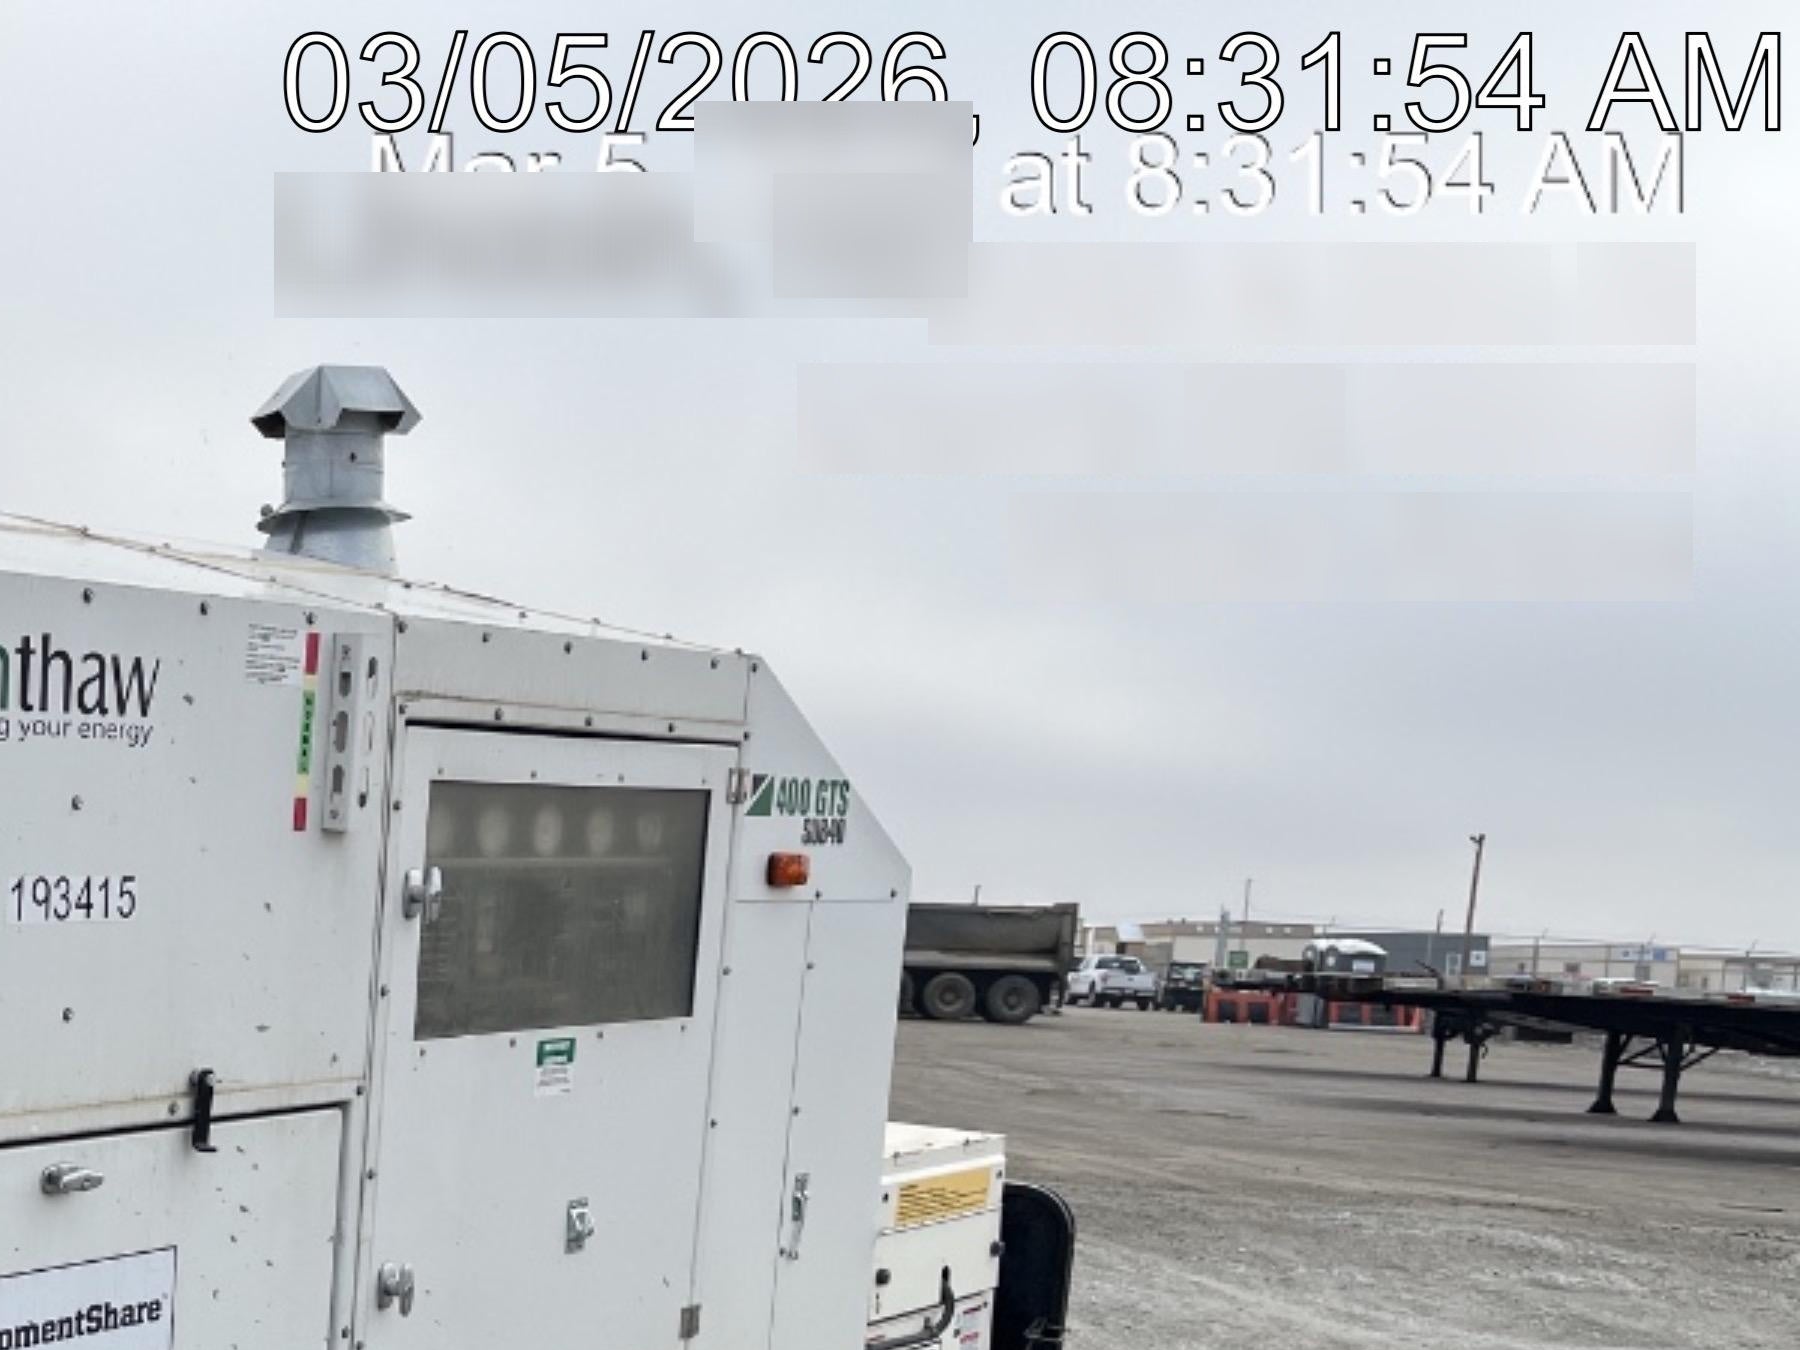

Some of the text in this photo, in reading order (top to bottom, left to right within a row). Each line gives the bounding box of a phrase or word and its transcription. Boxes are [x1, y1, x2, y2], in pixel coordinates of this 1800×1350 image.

[17, 718, 72, 742] your
[77, 719, 155, 747] energy
[776, 776, 850, 817] 400 GTS
[11, 875, 137, 922] 193415
